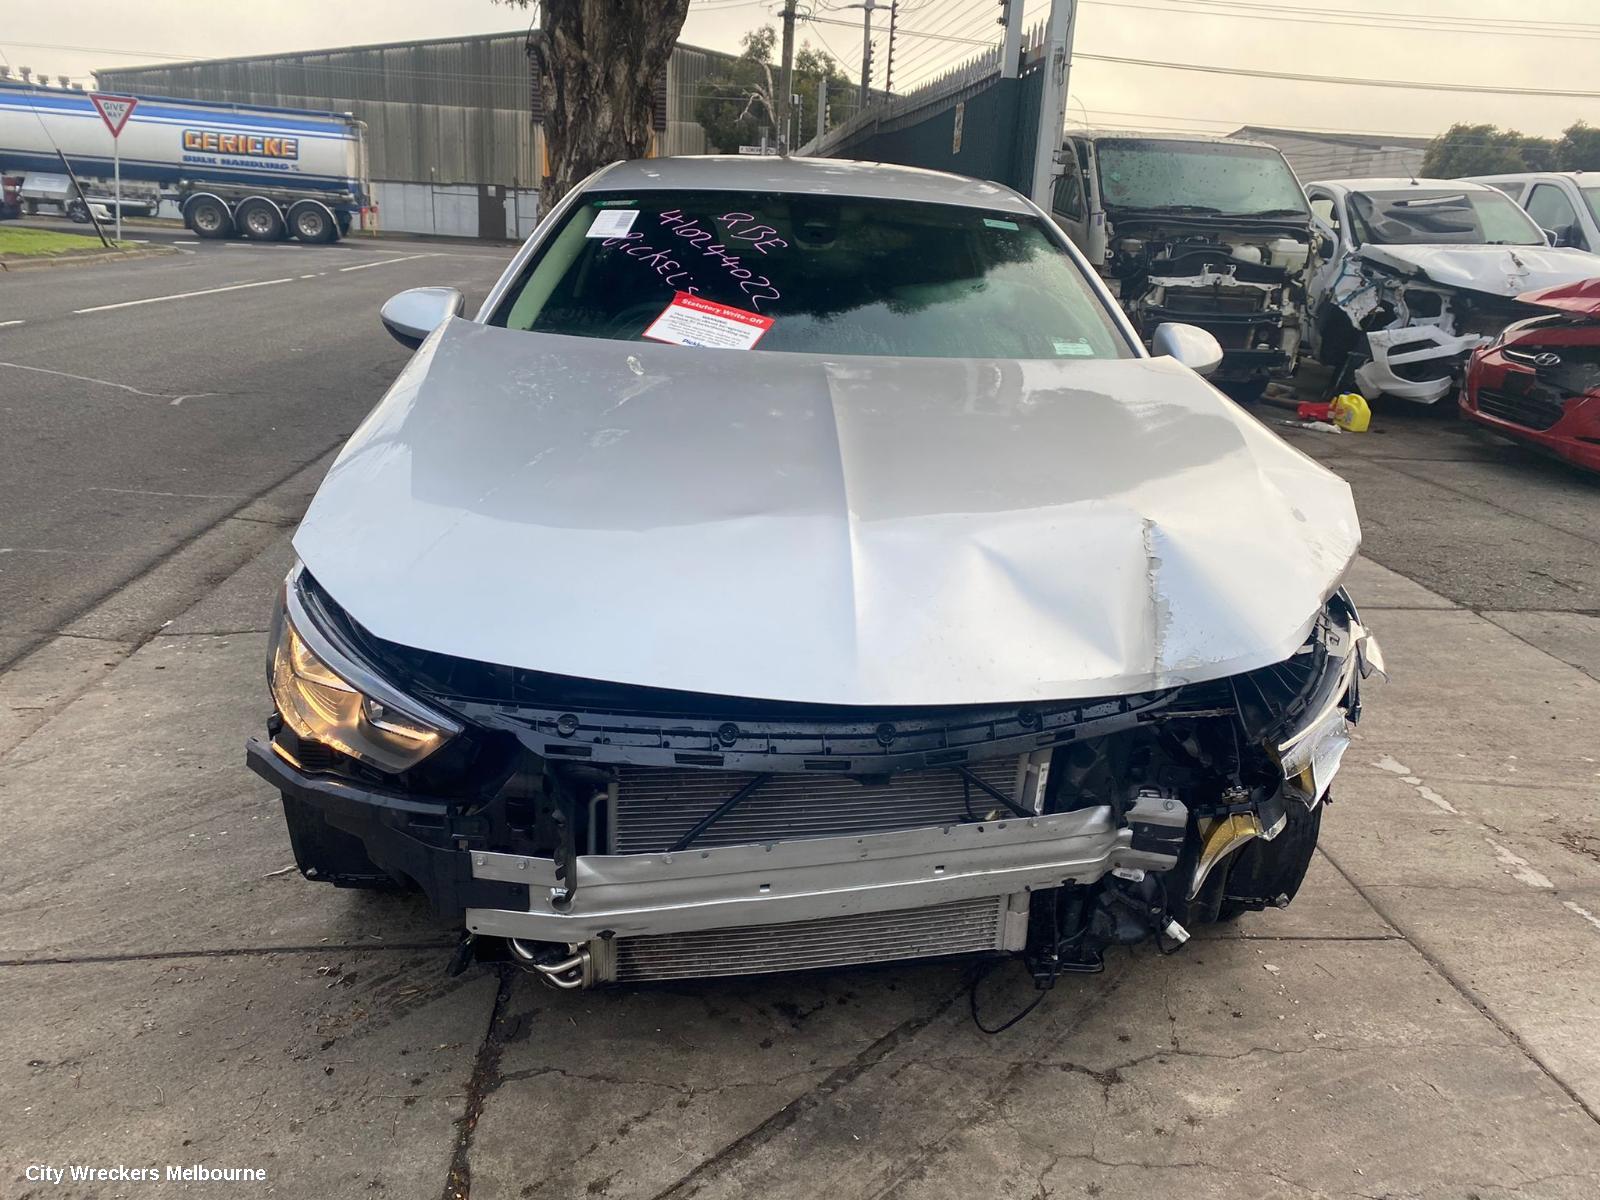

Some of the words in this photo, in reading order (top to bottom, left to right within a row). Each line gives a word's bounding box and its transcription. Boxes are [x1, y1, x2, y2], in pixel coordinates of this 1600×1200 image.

[103, 102, 125, 112] GIVE
[184, 130, 298, 158] GERICKE
[182, 154, 217, 165] BULK
[220, 158, 289, 170] HANDLING
[681, 297, 722, 315] Statutory
[722, 308, 765, 325] Write-Off
